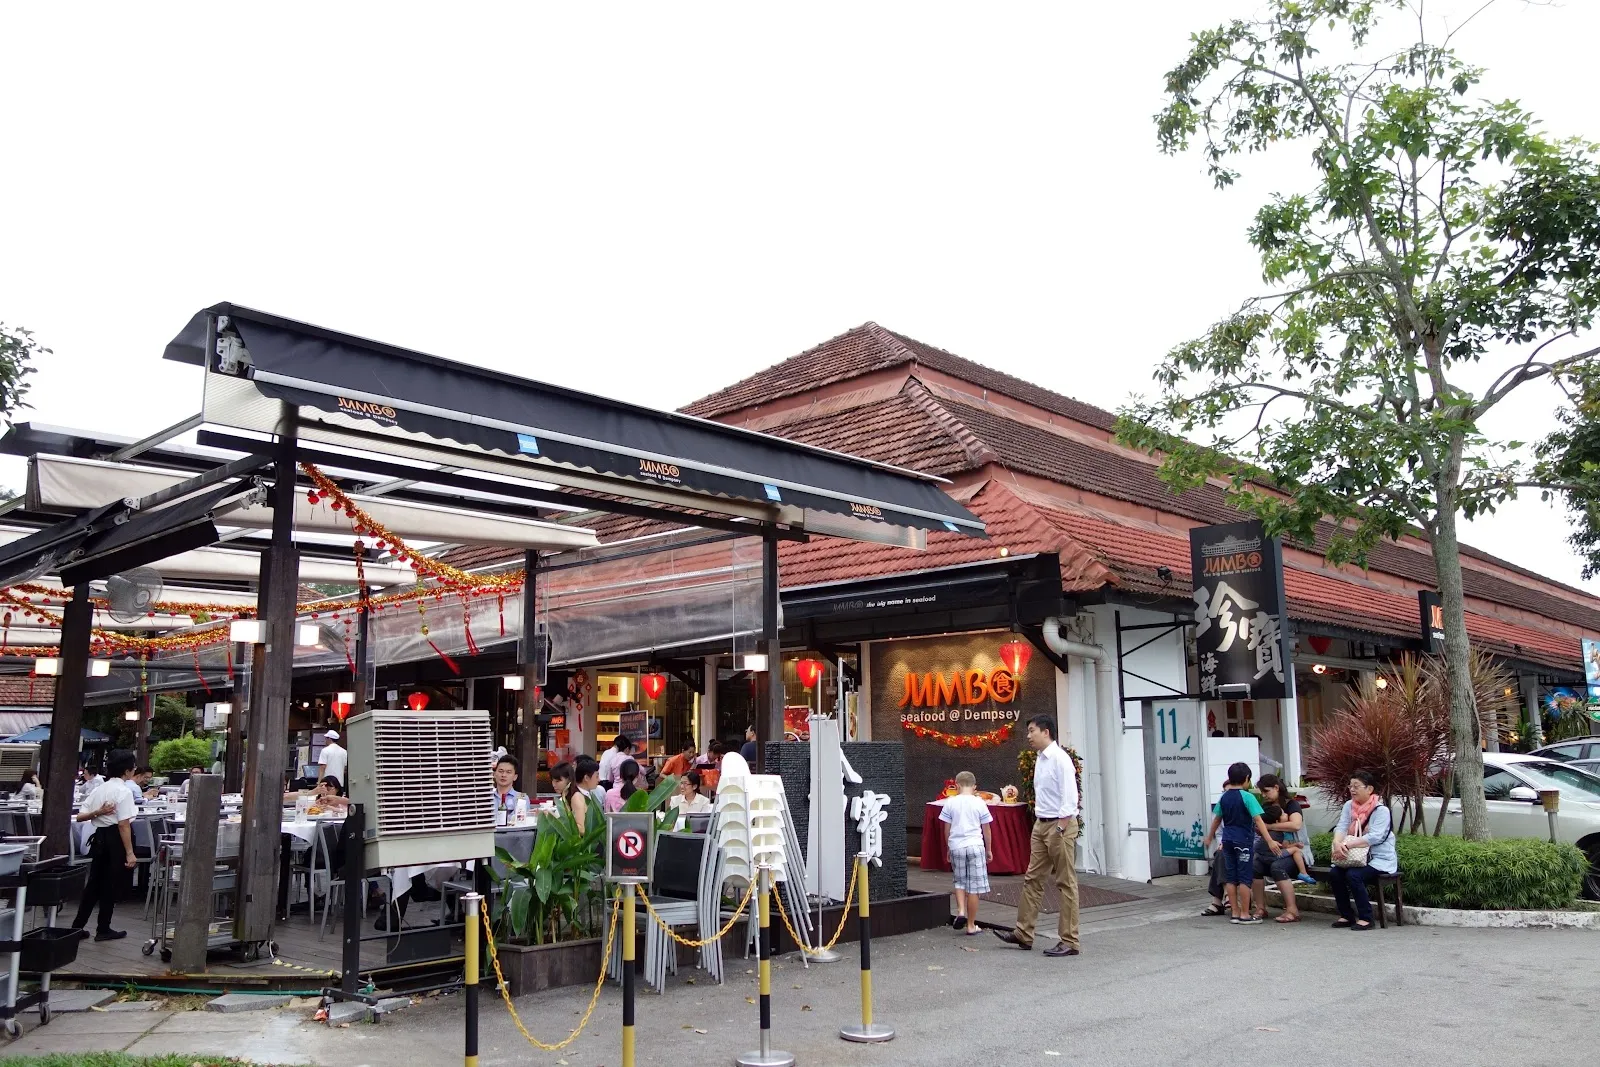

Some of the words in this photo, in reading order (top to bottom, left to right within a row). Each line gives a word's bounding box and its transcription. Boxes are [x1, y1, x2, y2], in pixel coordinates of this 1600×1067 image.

[338, 397, 396, 418] JUMBO
[639, 459, 680, 477] JUMBO
[1203, 552, 1262, 573] JUMBO
[912, 595, 937, 603] seafood
[897, 666, 1020, 708] JUMBO
[900, 709, 946, 722] seafood
[949, 709, 961, 721] @
[964, 708, 1021, 722] Dempsey
[1157, 708, 1178, 744] 11
